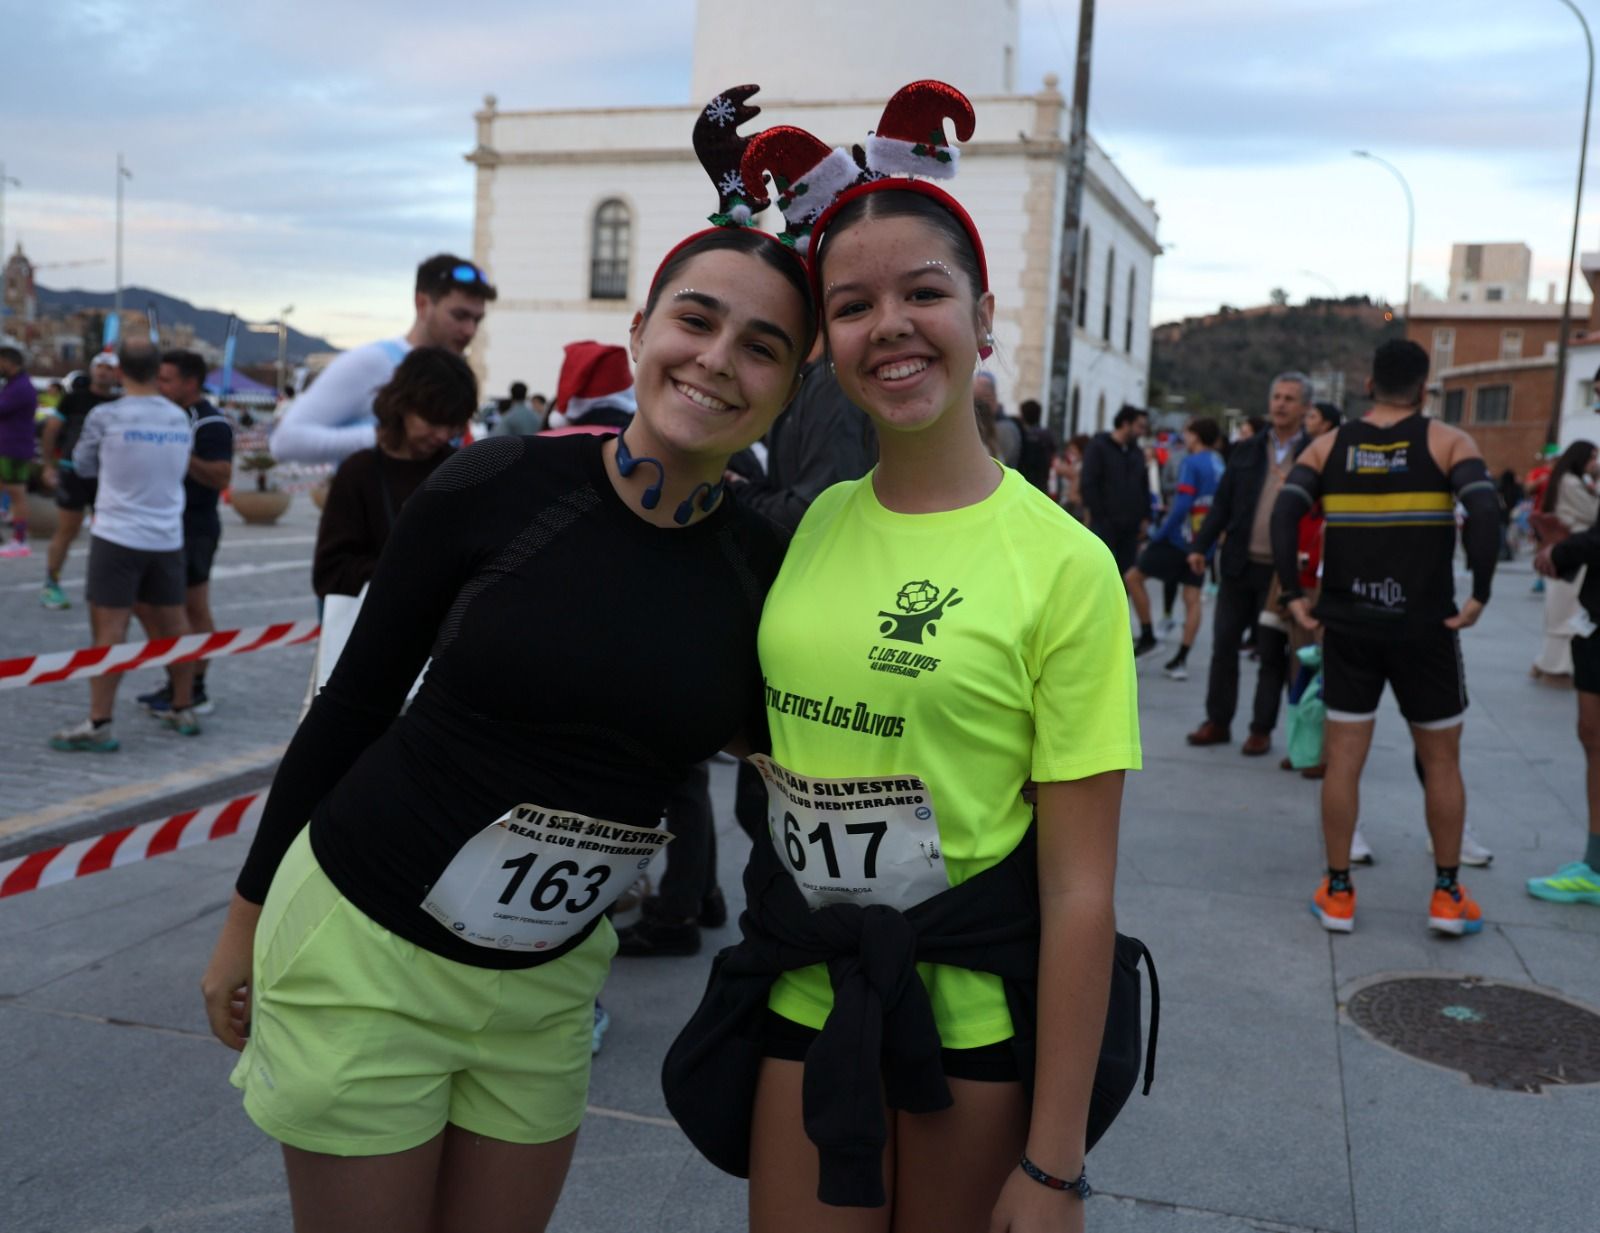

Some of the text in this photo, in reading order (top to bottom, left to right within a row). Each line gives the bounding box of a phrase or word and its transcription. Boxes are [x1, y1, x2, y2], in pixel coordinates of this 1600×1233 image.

[877, 648, 899, 662] LOS
[895, 650, 942, 672] OLIVOS
[877, 663, 921, 679] ANIVERSARIO
[784, 771, 809, 794] SAN
[813, 779, 925, 796] SILVESTRE
[789, 793, 812, 809] CLUB
[814, 795, 925, 811] MEDITERRÁNEO
[508, 823, 542, 842] REAL
[544, 834, 576, 848] CLUB
[516, 807, 669, 846] VII SAN SILVESTRE
[784, 811, 888, 879] 617
[497, 852, 612, 914] 163
